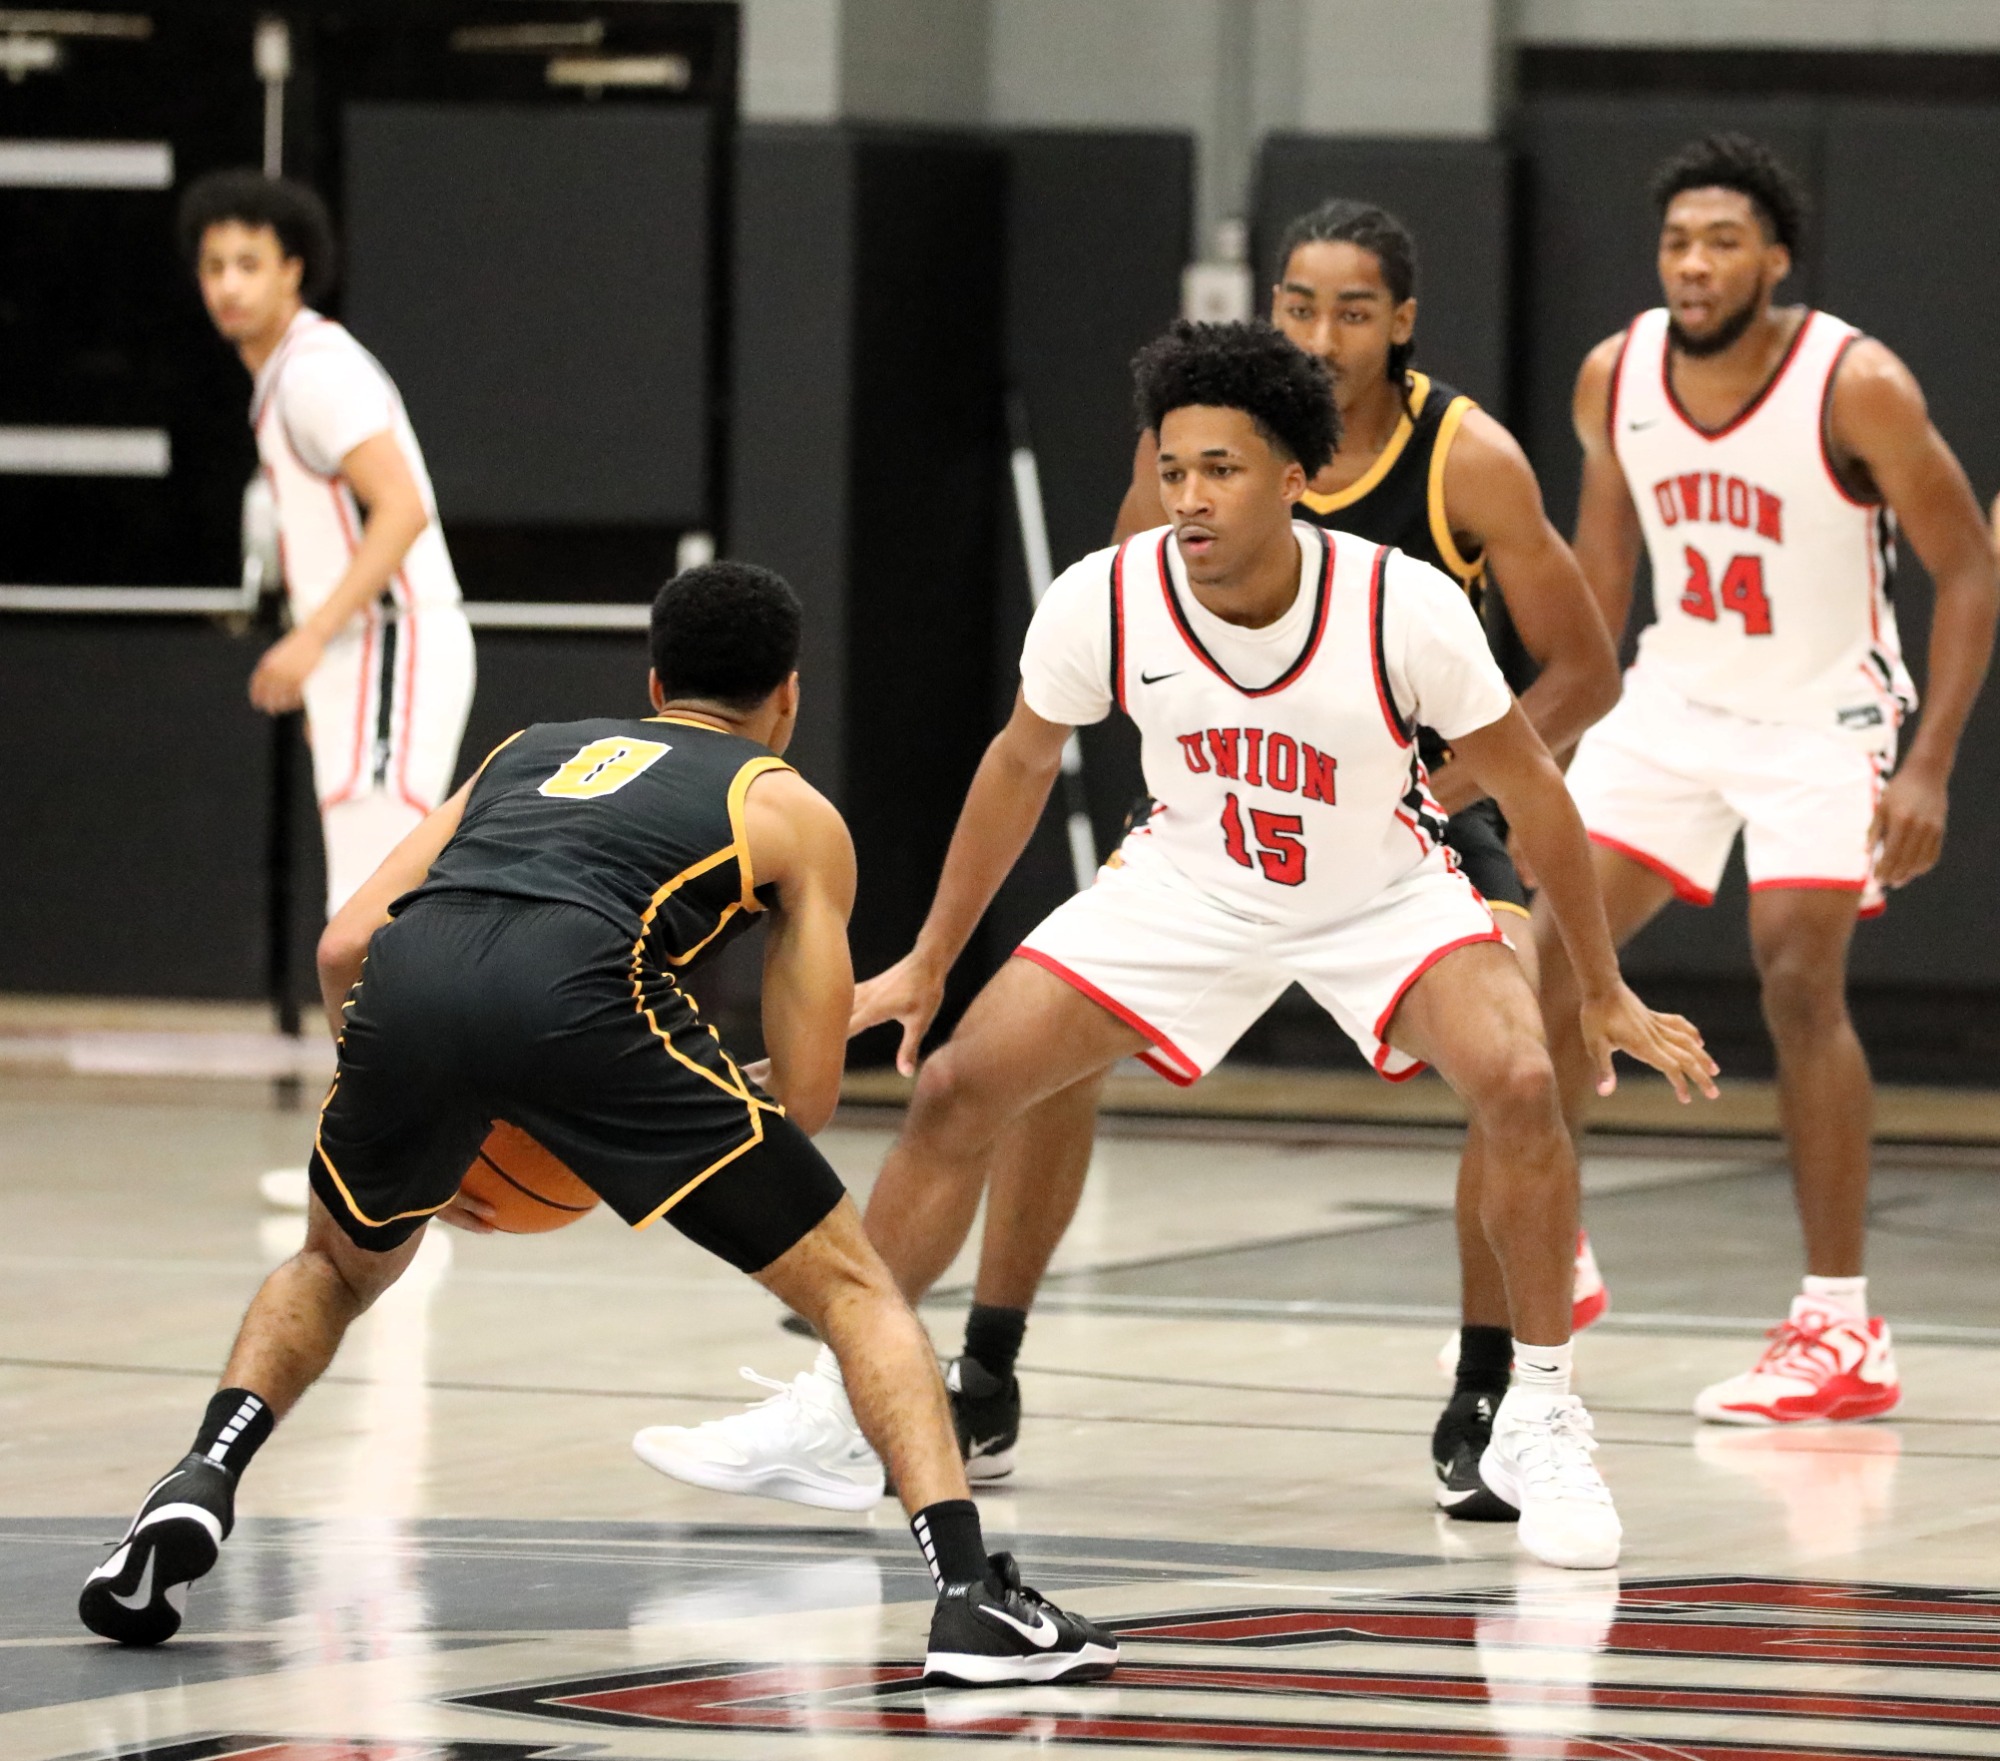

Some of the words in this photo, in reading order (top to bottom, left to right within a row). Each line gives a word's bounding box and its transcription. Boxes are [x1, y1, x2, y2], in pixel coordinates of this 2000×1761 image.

[1653, 471, 1783, 544] UNION
[1177, 728, 1337, 806] UNION
[1219, 792, 1307, 887] 15
